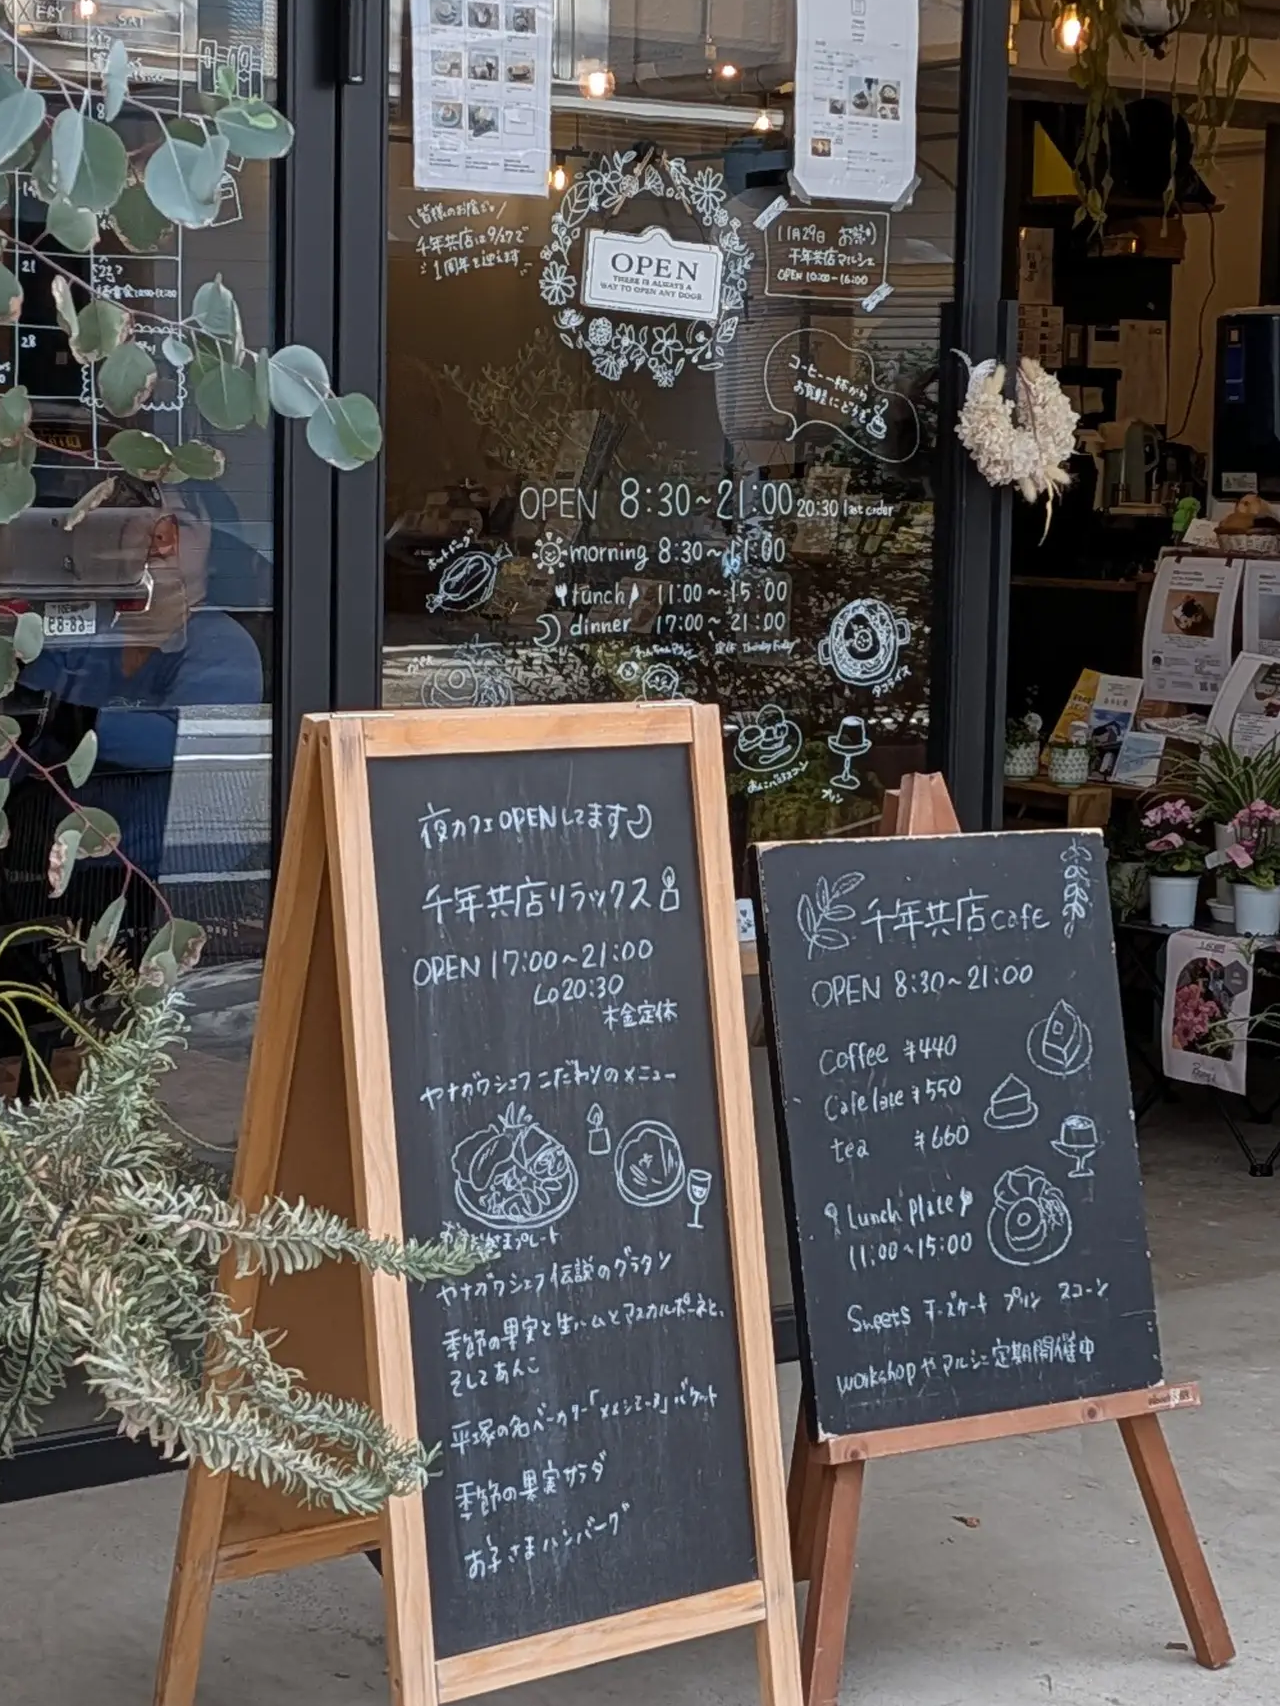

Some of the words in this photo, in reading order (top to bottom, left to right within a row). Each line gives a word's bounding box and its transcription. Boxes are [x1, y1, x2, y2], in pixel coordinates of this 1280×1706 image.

[611, 253, 699, 282] OPEN
[777, 268, 803, 282] OPEN
[620, 284, 632, 293] TO
[519, 486, 599, 521] OPEN
[797, 498, 839, 518] 20:30
[569, 541, 650, 572] morning
[569, 614, 633, 637] dinner
[421, 877, 653, 926] 千年共店リラックス
[412, 955, 481, 989] OPEN
[811, 974, 881, 1009] OPEN
[603, 999, 679, 1032] 木金定休
[819, 1042, 889, 1077] Coffee
[829, 1135, 870, 1164] tea
[847, 1302, 912, 1334] Sweets
[449, 1357, 540, 1398] そしてあんこ
